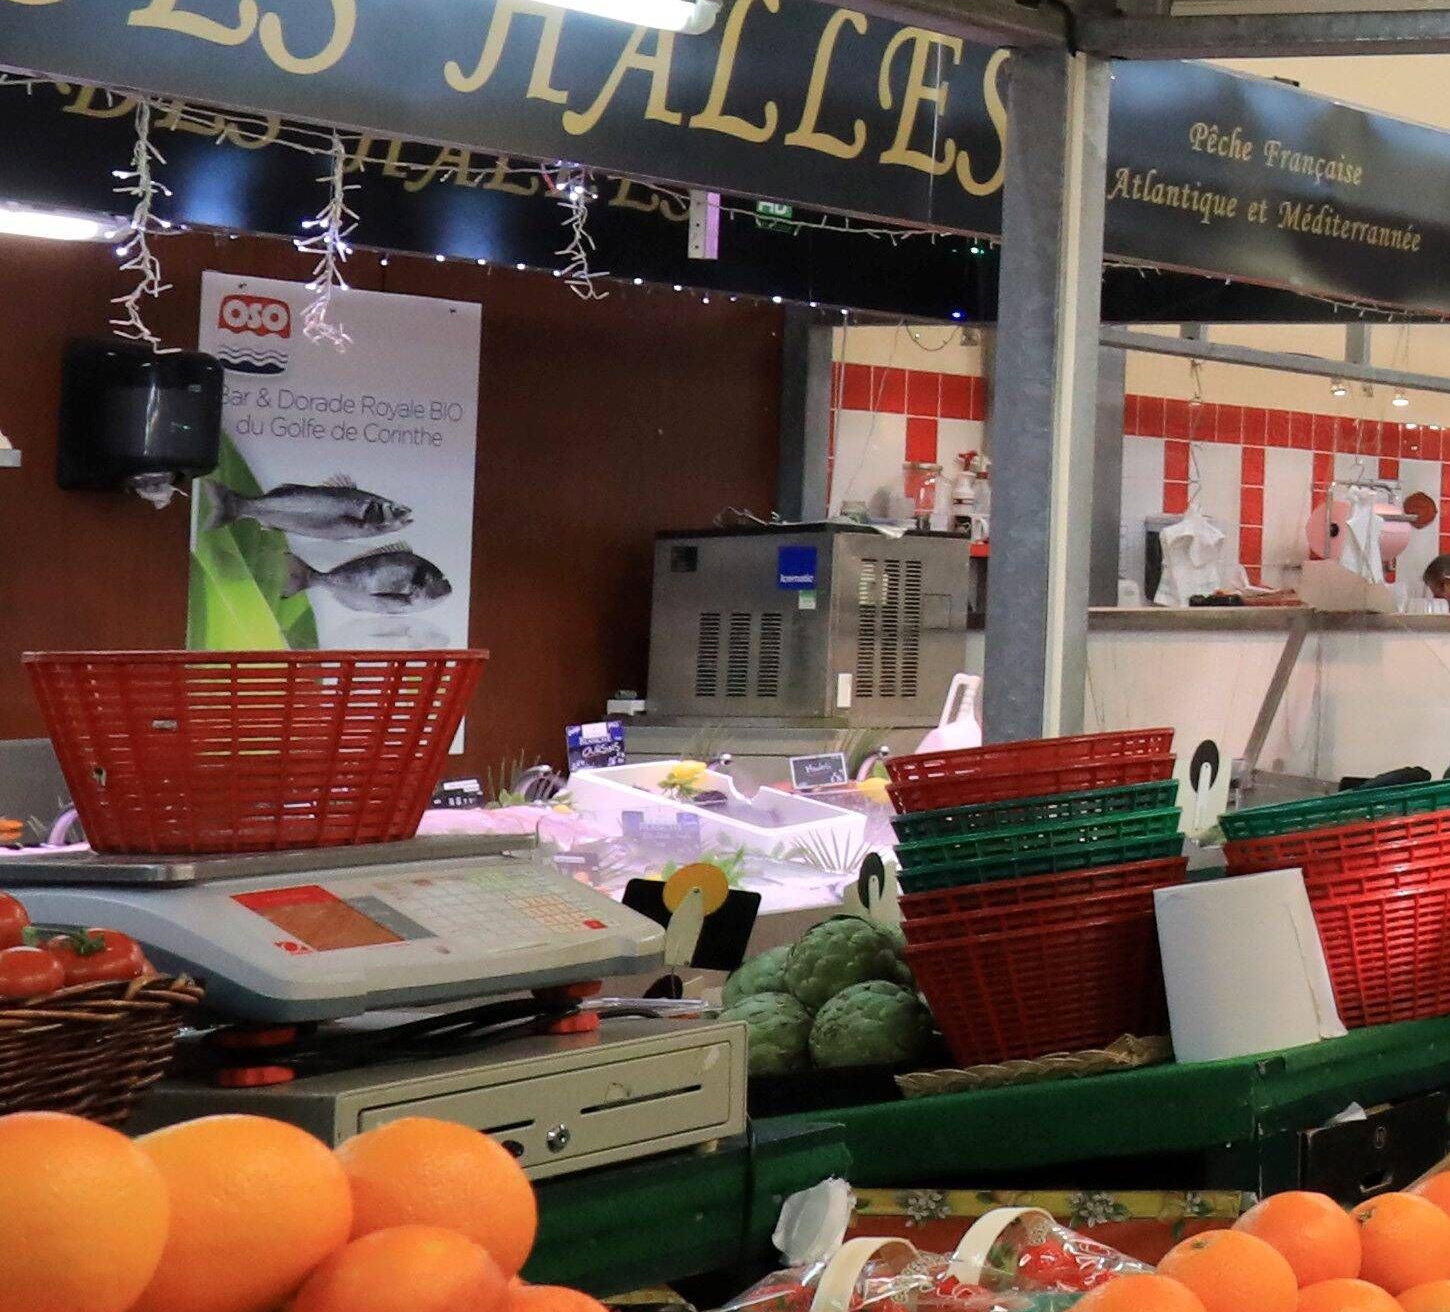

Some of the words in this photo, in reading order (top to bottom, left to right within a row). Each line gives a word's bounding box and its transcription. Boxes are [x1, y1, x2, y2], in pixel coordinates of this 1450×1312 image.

[1190, 121, 1252, 162] Pêche
[1264, 139, 1362, 186] Française
[1106, 167, 1237, 225] Atlantique
[1248, 197, 1268, 225] et
[1278, 200, 1421, 252] Méditerrannée
[222, 299, 288, 330] OSO
[256, 389, 271, 408] &
[278, 389, 354, 413] Dorade
[361, 395, 425, 421] Royale
[431, 402, 463, 422] BIO
[236, 415, 264, 436] du
[270, 417, 326, 439] Golfe
[331, 420, 358, 441] de
[363, 423, 443, 447] Corinthe
